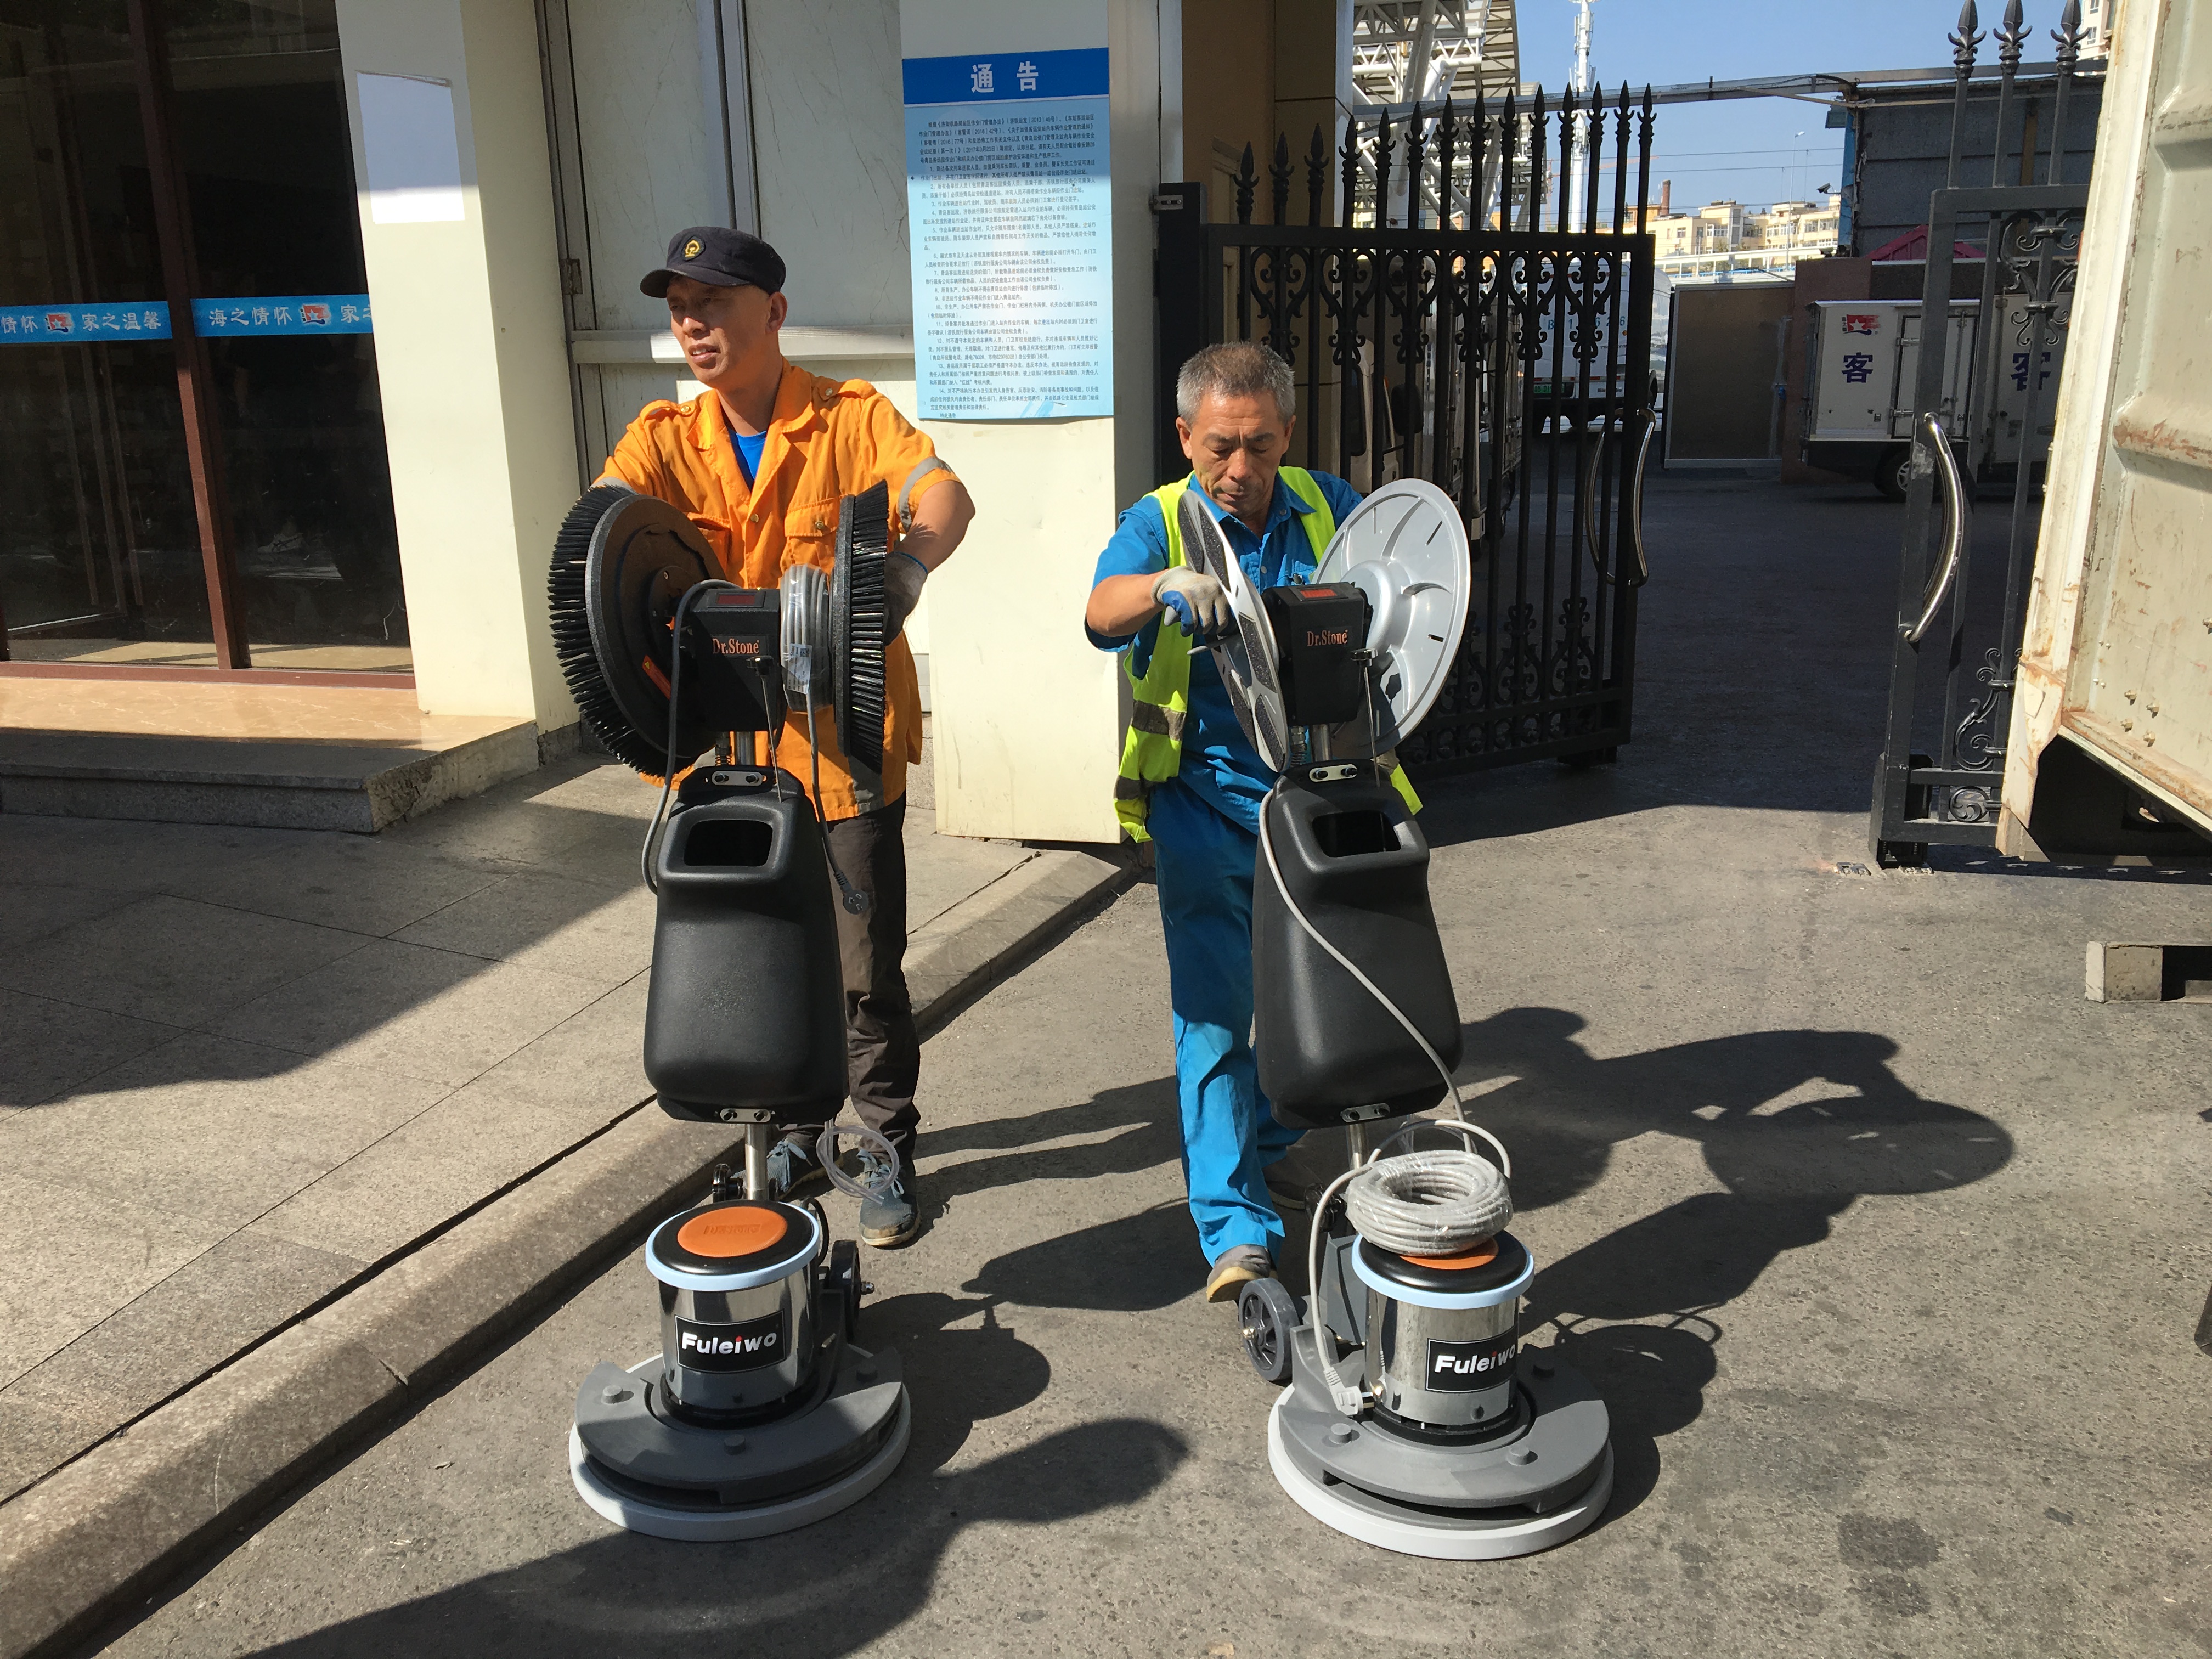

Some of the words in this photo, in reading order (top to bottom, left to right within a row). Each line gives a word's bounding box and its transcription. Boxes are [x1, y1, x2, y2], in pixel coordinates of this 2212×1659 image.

[970, 61, 1039, 93] 通告
[1, 315, 38, 334] 情怀
[82, 310, 161, 331] 家之温馨
[208, 306, 293, 328] 海之情怀
[1841, 352, 1874, 383] 客
[713, 637, 760, 654] Dr.Stone
[1307, 630, 1348, 647] Dr.Stone
[681, 1331, 777, 1355] Fuleiwo
[1434, 1344, 1516, 1374] Fuleiwo
